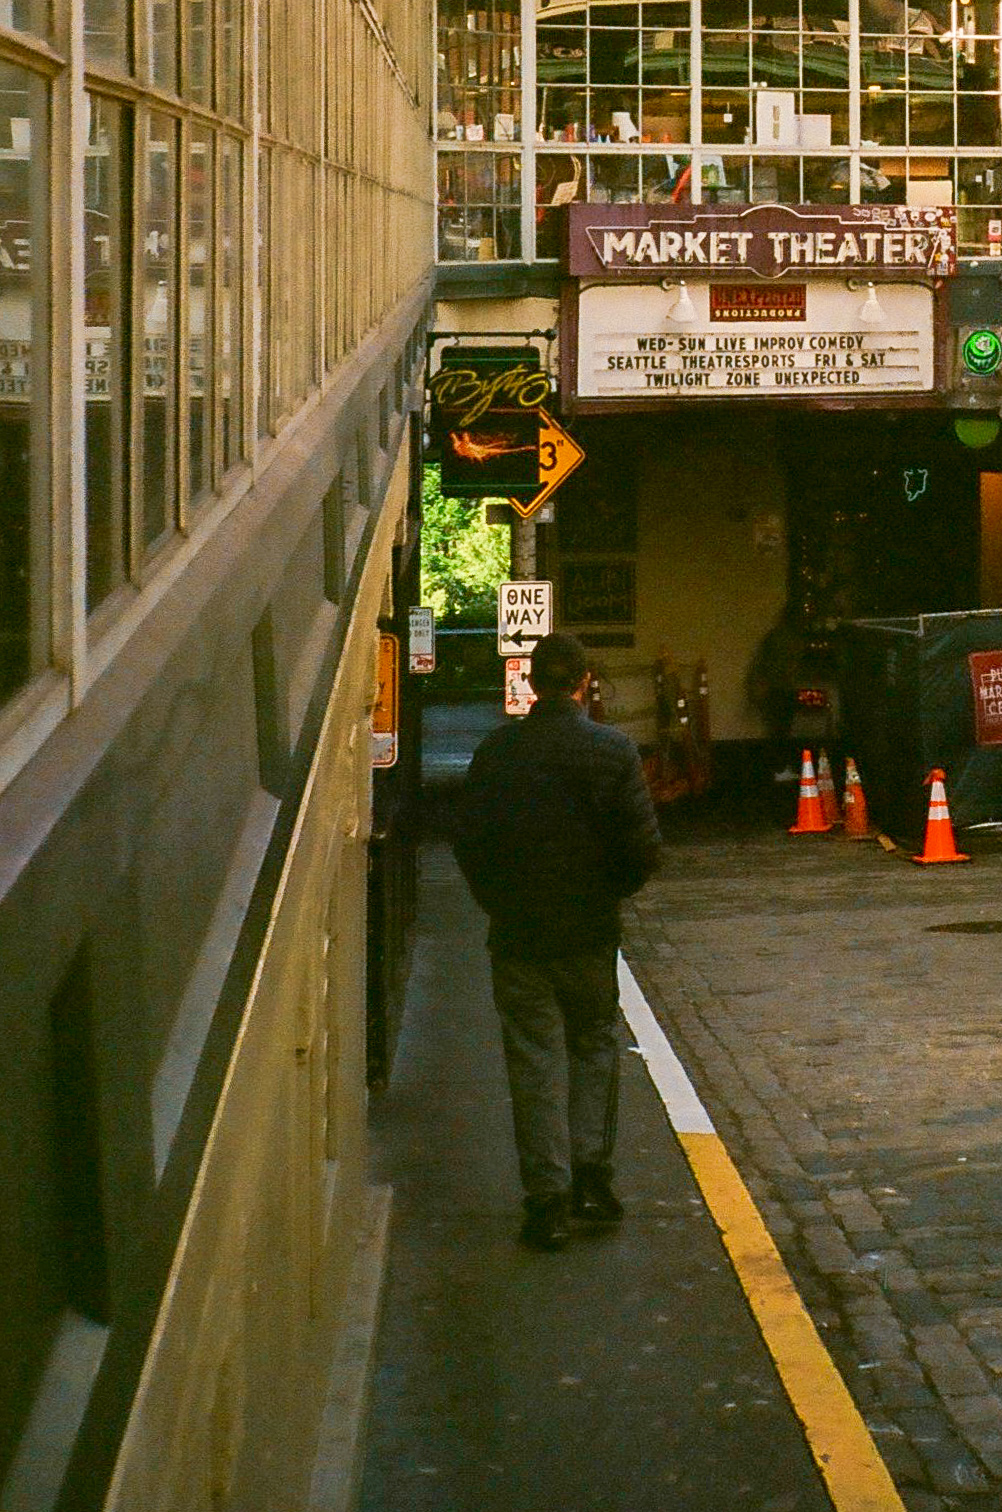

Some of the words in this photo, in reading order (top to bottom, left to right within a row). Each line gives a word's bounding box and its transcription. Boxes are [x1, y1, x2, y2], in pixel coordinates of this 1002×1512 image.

[602, 231, 753, 264] MARKET
[768, 232, 928, 265] THEATER
[714, 309, 801, 318] PRODUCTIONS
[679, 338, 706, 351] SUN
[715, 337, 746, 351] LIVE
[754, 337, 804, 350] IMPROV
[809, 336, 864, 349] COMEDY
[607, 356, 667, 370] SEATTLE
[682, 354, 795, 369] THEATRESPORTS
[815, 354, 836, 367] FRI
[845, 354, 853, 367] &
[861, 353, 886, 366] SAT
[645, 373, 711, 387] TWILIGHT
[727, 372, 760, 386] ZONE
[775, 371, 860, 385] UNEXPECTED
[507, 589, 544, 605] ONE
[506, 609, 544, 625] WAY
